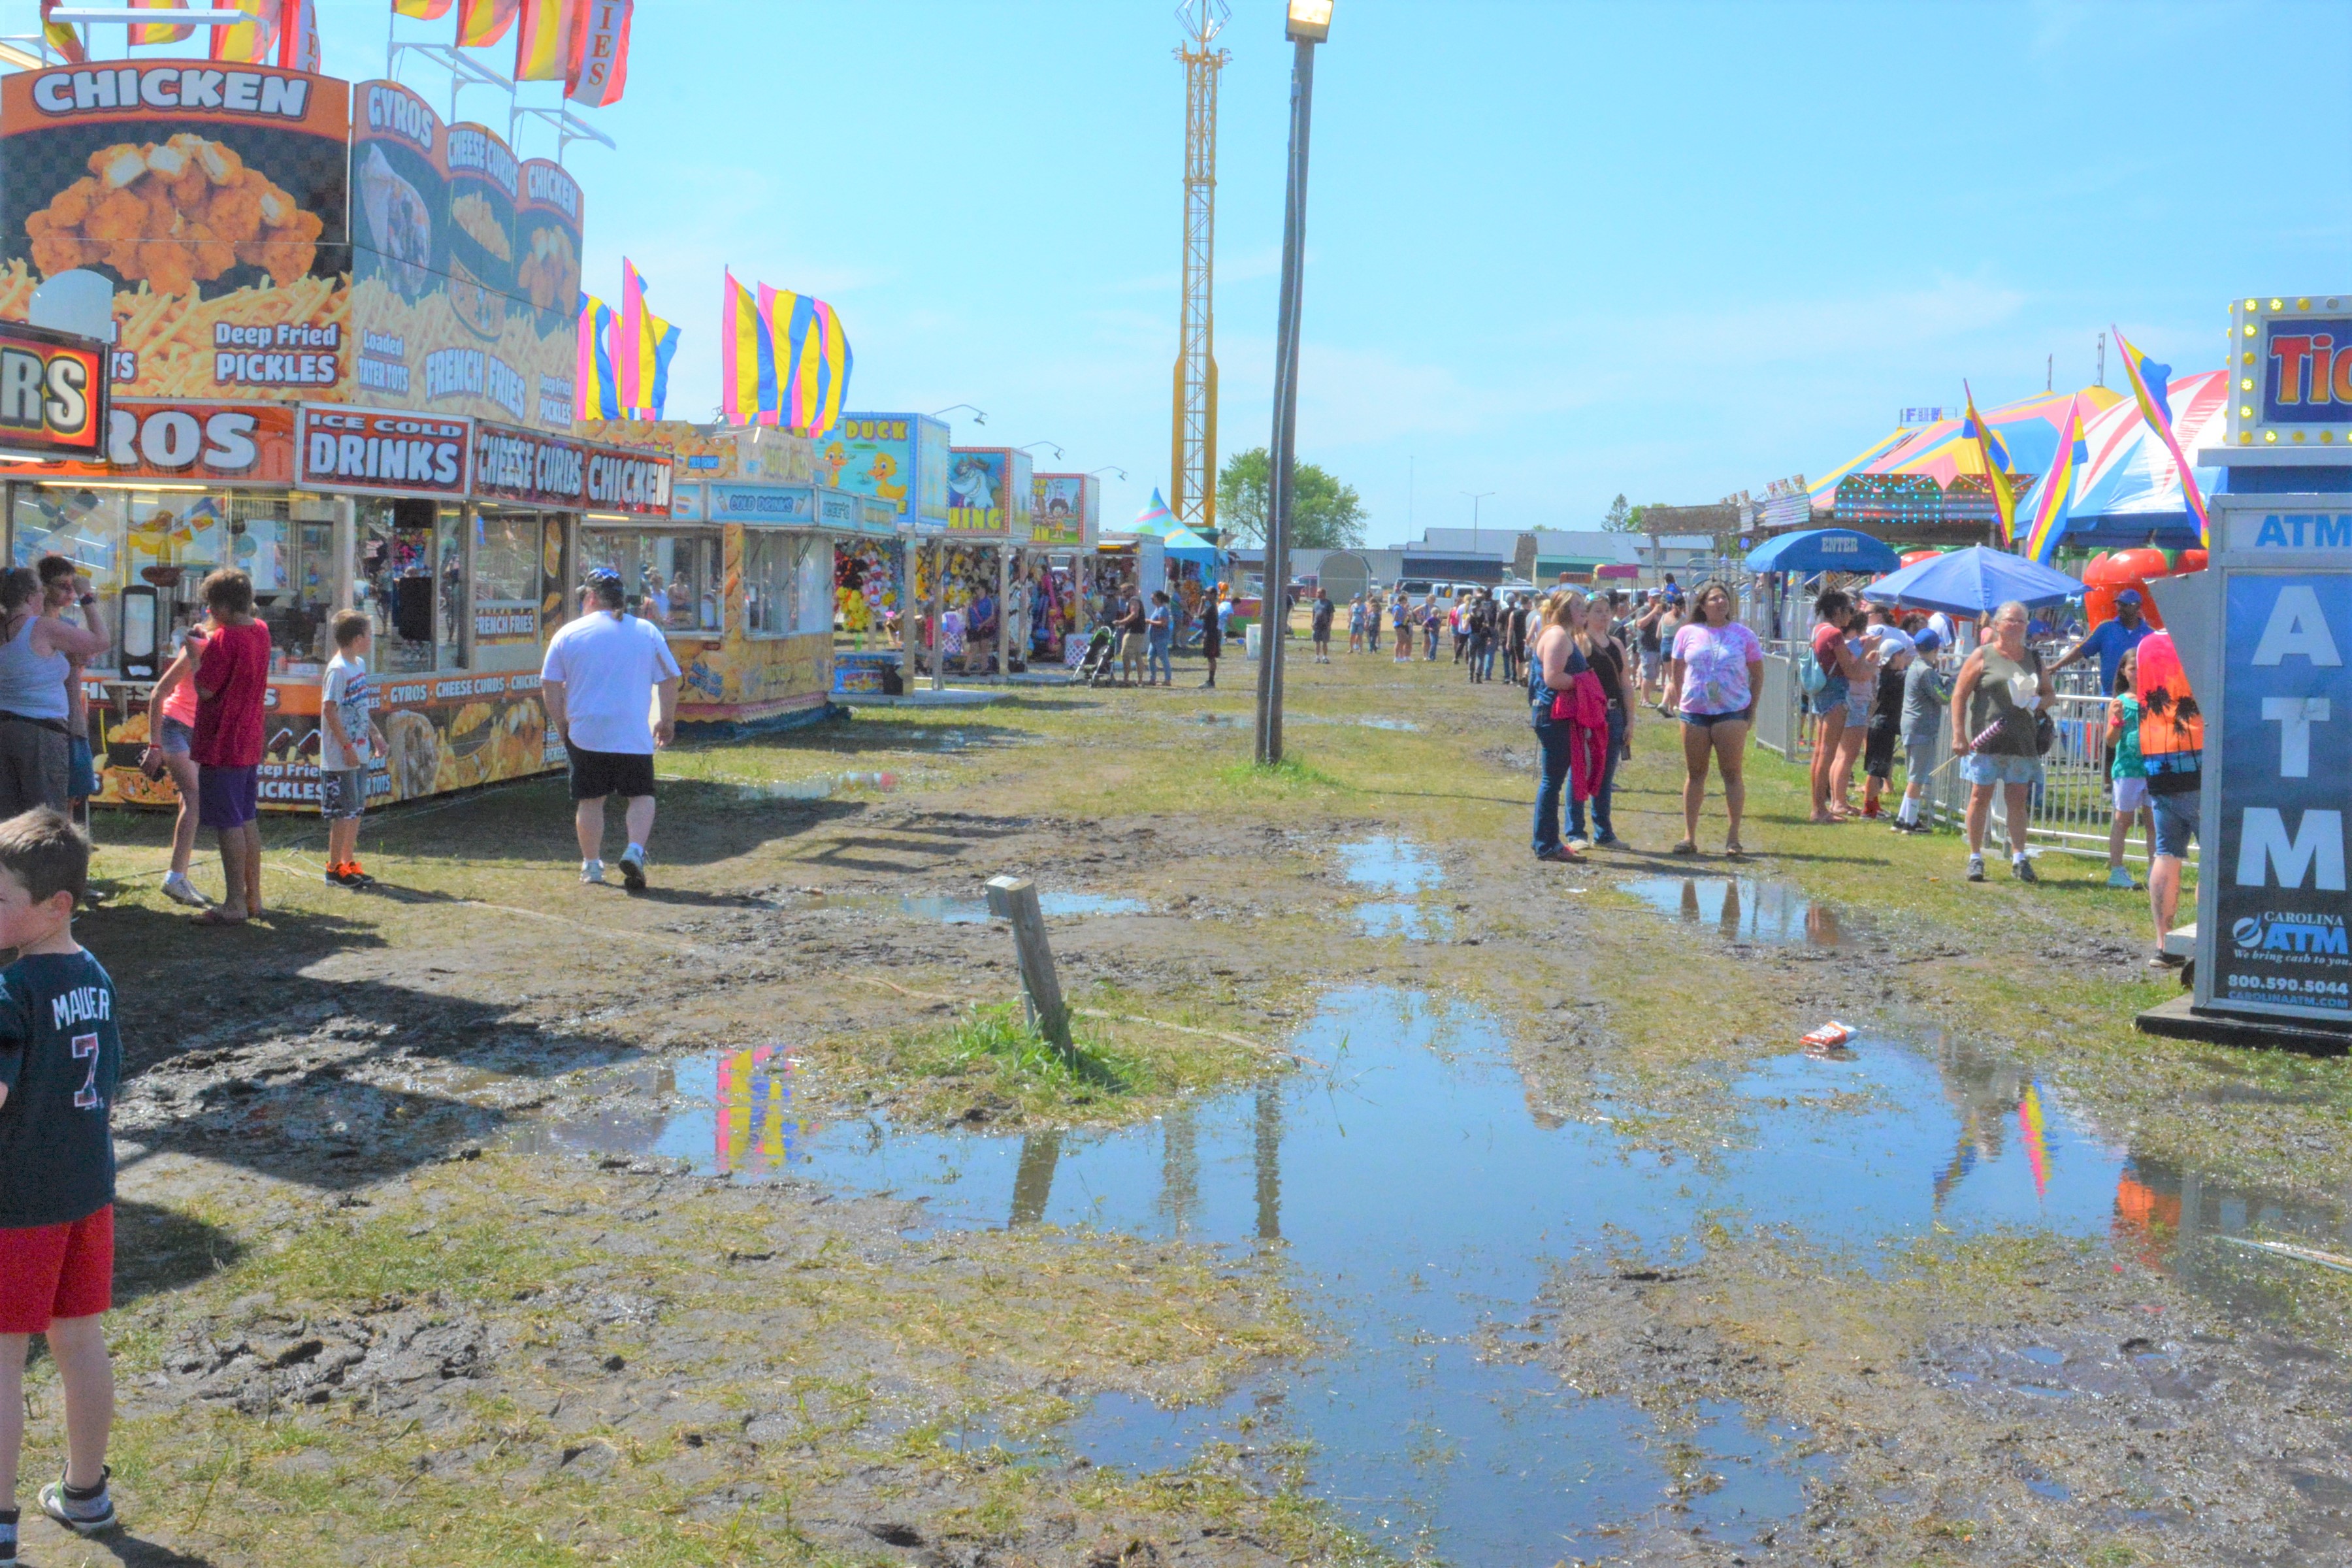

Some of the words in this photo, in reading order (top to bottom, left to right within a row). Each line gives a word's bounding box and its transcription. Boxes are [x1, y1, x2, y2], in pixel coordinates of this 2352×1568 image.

[588, 0, 620, 86] IES
[33, 68, 308, 116] CHICKEN
[368, 86, 434, 149] GYROS
[448, 129, 486, 170] CHEESE
[487, 138, 519, 197] CURDS
[528, 164, 578, 218] CHICKEN
[215, 323, 272, 348] Deep
[277, 323, 336, 346] Fried
[363, 329, 404, 357] Loaded
[216, 354, 335, 382] PICKLES
[358, 357, 385, 387] TATER
[385, 363, 409, 392] TOTS
[426, 348, 485, 400] FRENCH
[488, 355, 526, 420] FRIES
[309, 414, 367, 431] ICE
[374, 419, 463, 437] COLD
[540, 397, 572, 425] PICKLES
[108, 408, 257, 469] ROS
[845, 419, 907, 440] DUCK
[308, 432, 459, 484] DRINKS
[478, 434, 534, 489] CHEESE
[536, 444, 583, 496] CURDS
[588, 454, 670, 506] CHICKEN
[730, 495, 756, 512] COLD
[757, 495, 794, 513] DRINKS
[1821, 536, 1859, 553] ENTER
[2254, 514, 2352, 547] ATM
[510, 614, 534, 633] FRIES
[390, 684, 427, 704] GYROS
[436, 679, 473, 698] CHEESE
[474, 677, 505, 694] CURDS
[511, 674, 541, 690] CHICKE
[2236, 585, 2347, 892] ATM
[257, 764, 283, 778] eep
[286, 764, 321, 777] Frie
[257, 781, 323, 800] ICKLES
[2264, 911, 2344, 926] CAROLINA
[2262, 922, 2349, 955] ATM
[2234, 949, 2250, 959] We
[2251, 951, 2283, 964] bring
[2285, 953, 2311, 964] cash
[2313, 955, 2326, 964] to
[2228, 974, 2349, 995] 800.590.5044
[2228, 990, 2349, 1008] CAROLINAATM.COM
[52, 986, 110, 1030] MAUER
[72, 1032, 99, 1107] 7
